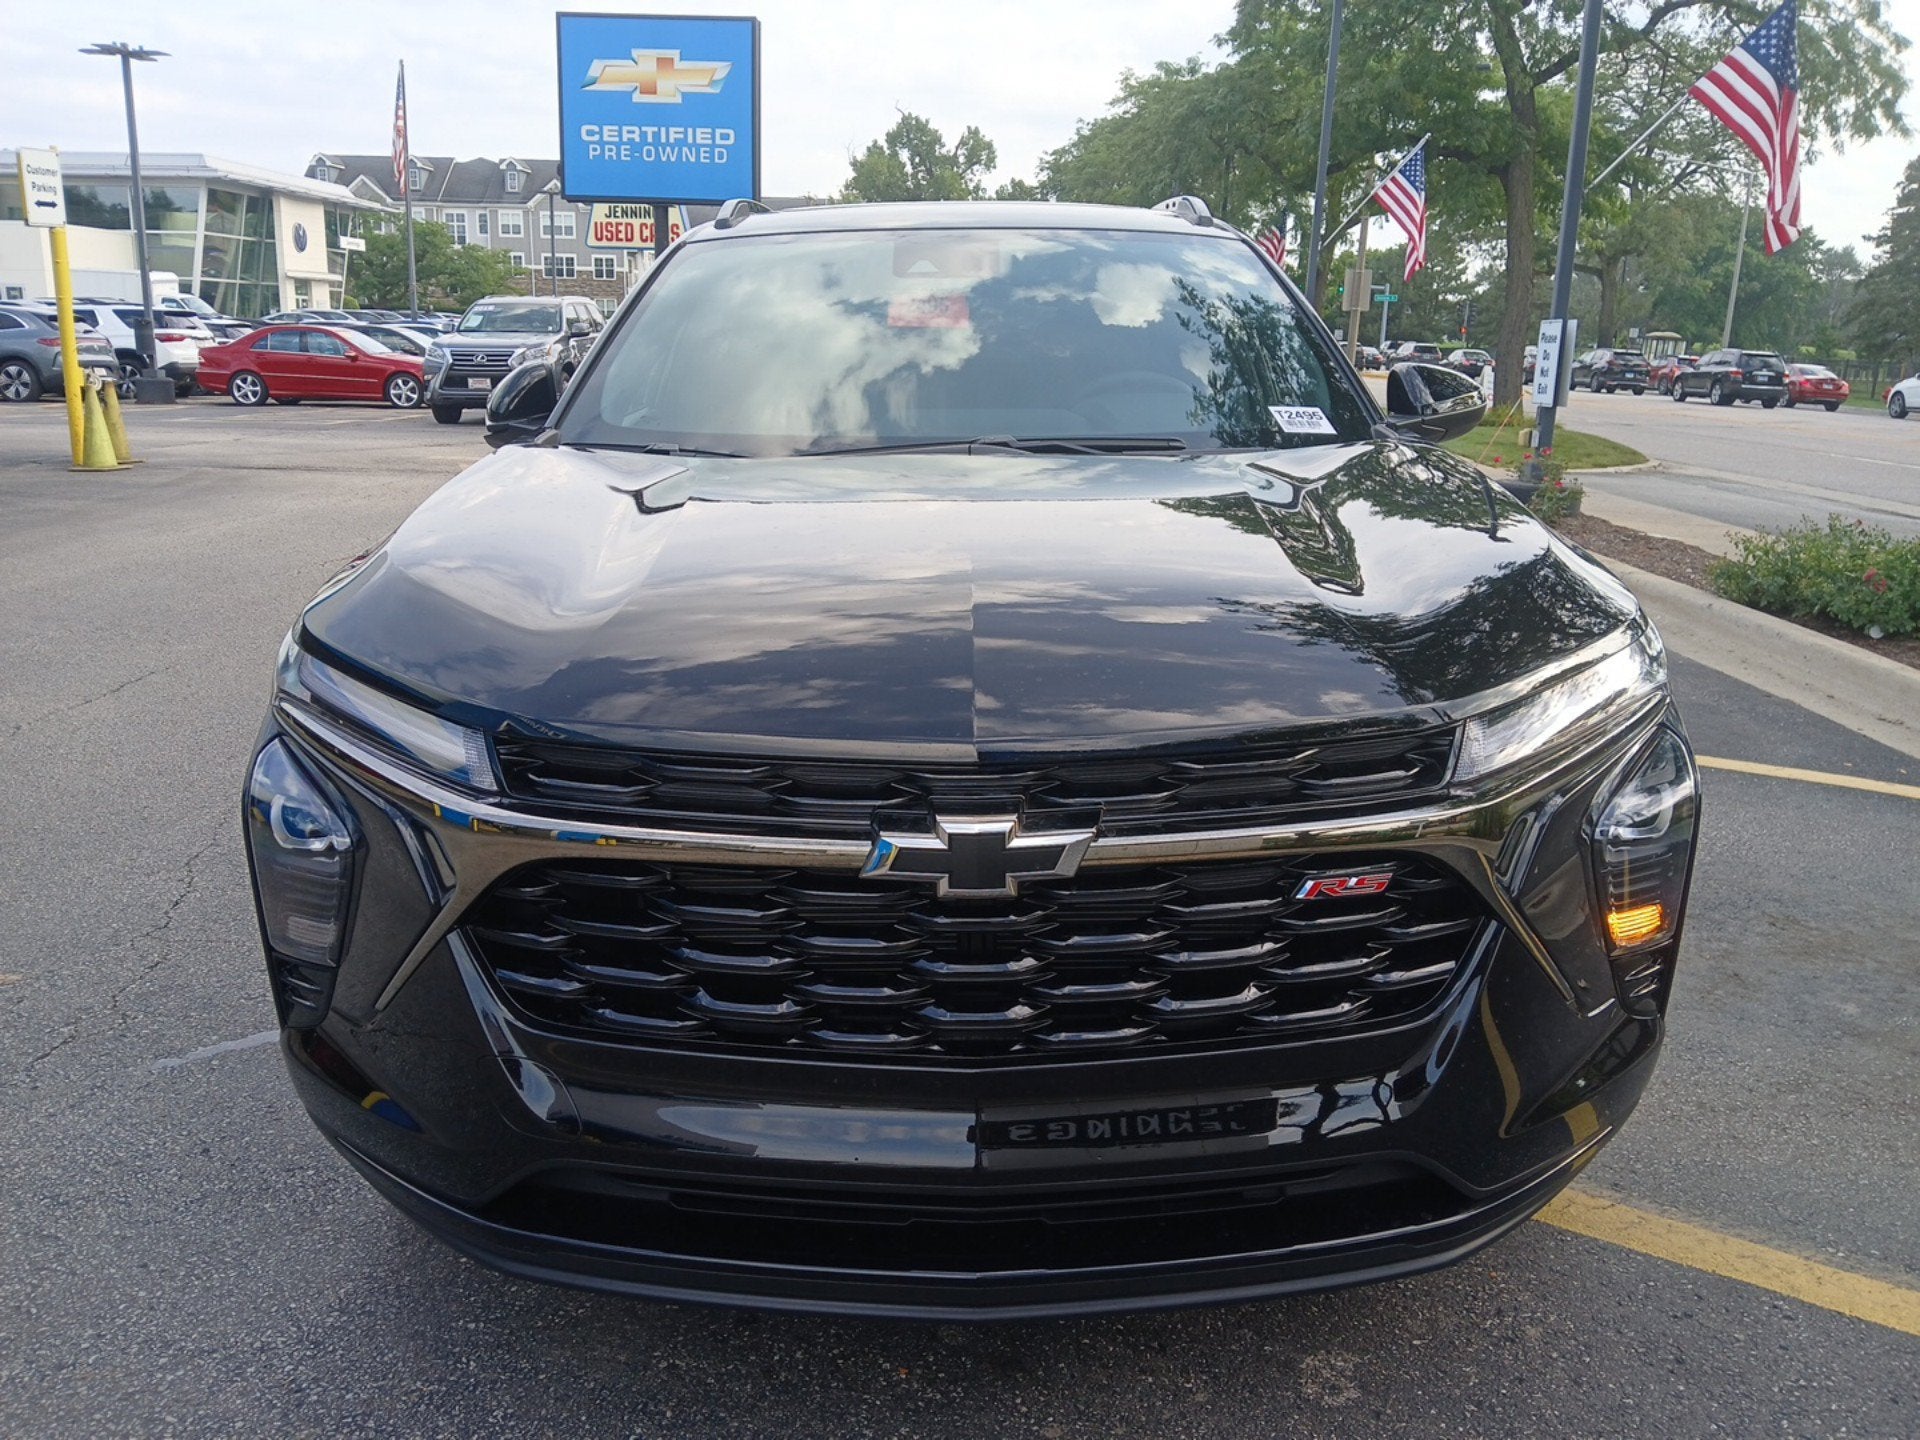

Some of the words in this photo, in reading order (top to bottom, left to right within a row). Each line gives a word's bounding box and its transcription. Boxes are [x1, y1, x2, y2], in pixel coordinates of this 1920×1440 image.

[580, 124, 736, 146] CERTIFIED
[588, 144, 728, 164] PRE-OWNED
[26, 164, 58, 177] Customer
[31, 181, 57, 196] Parking
[604, 205, 653, 219] JENNIN
[594, 221, 634, 243] USED
[639, 222, 681, 244] CAS
[1541, 332, 1558, 344] Please
[1542, 349, 1551, 361] Do
[1537, 383, 1549, 395] Exit
[1274, 410, 1323, 421] T2495
[1298, 873, 1393, 899] RS
